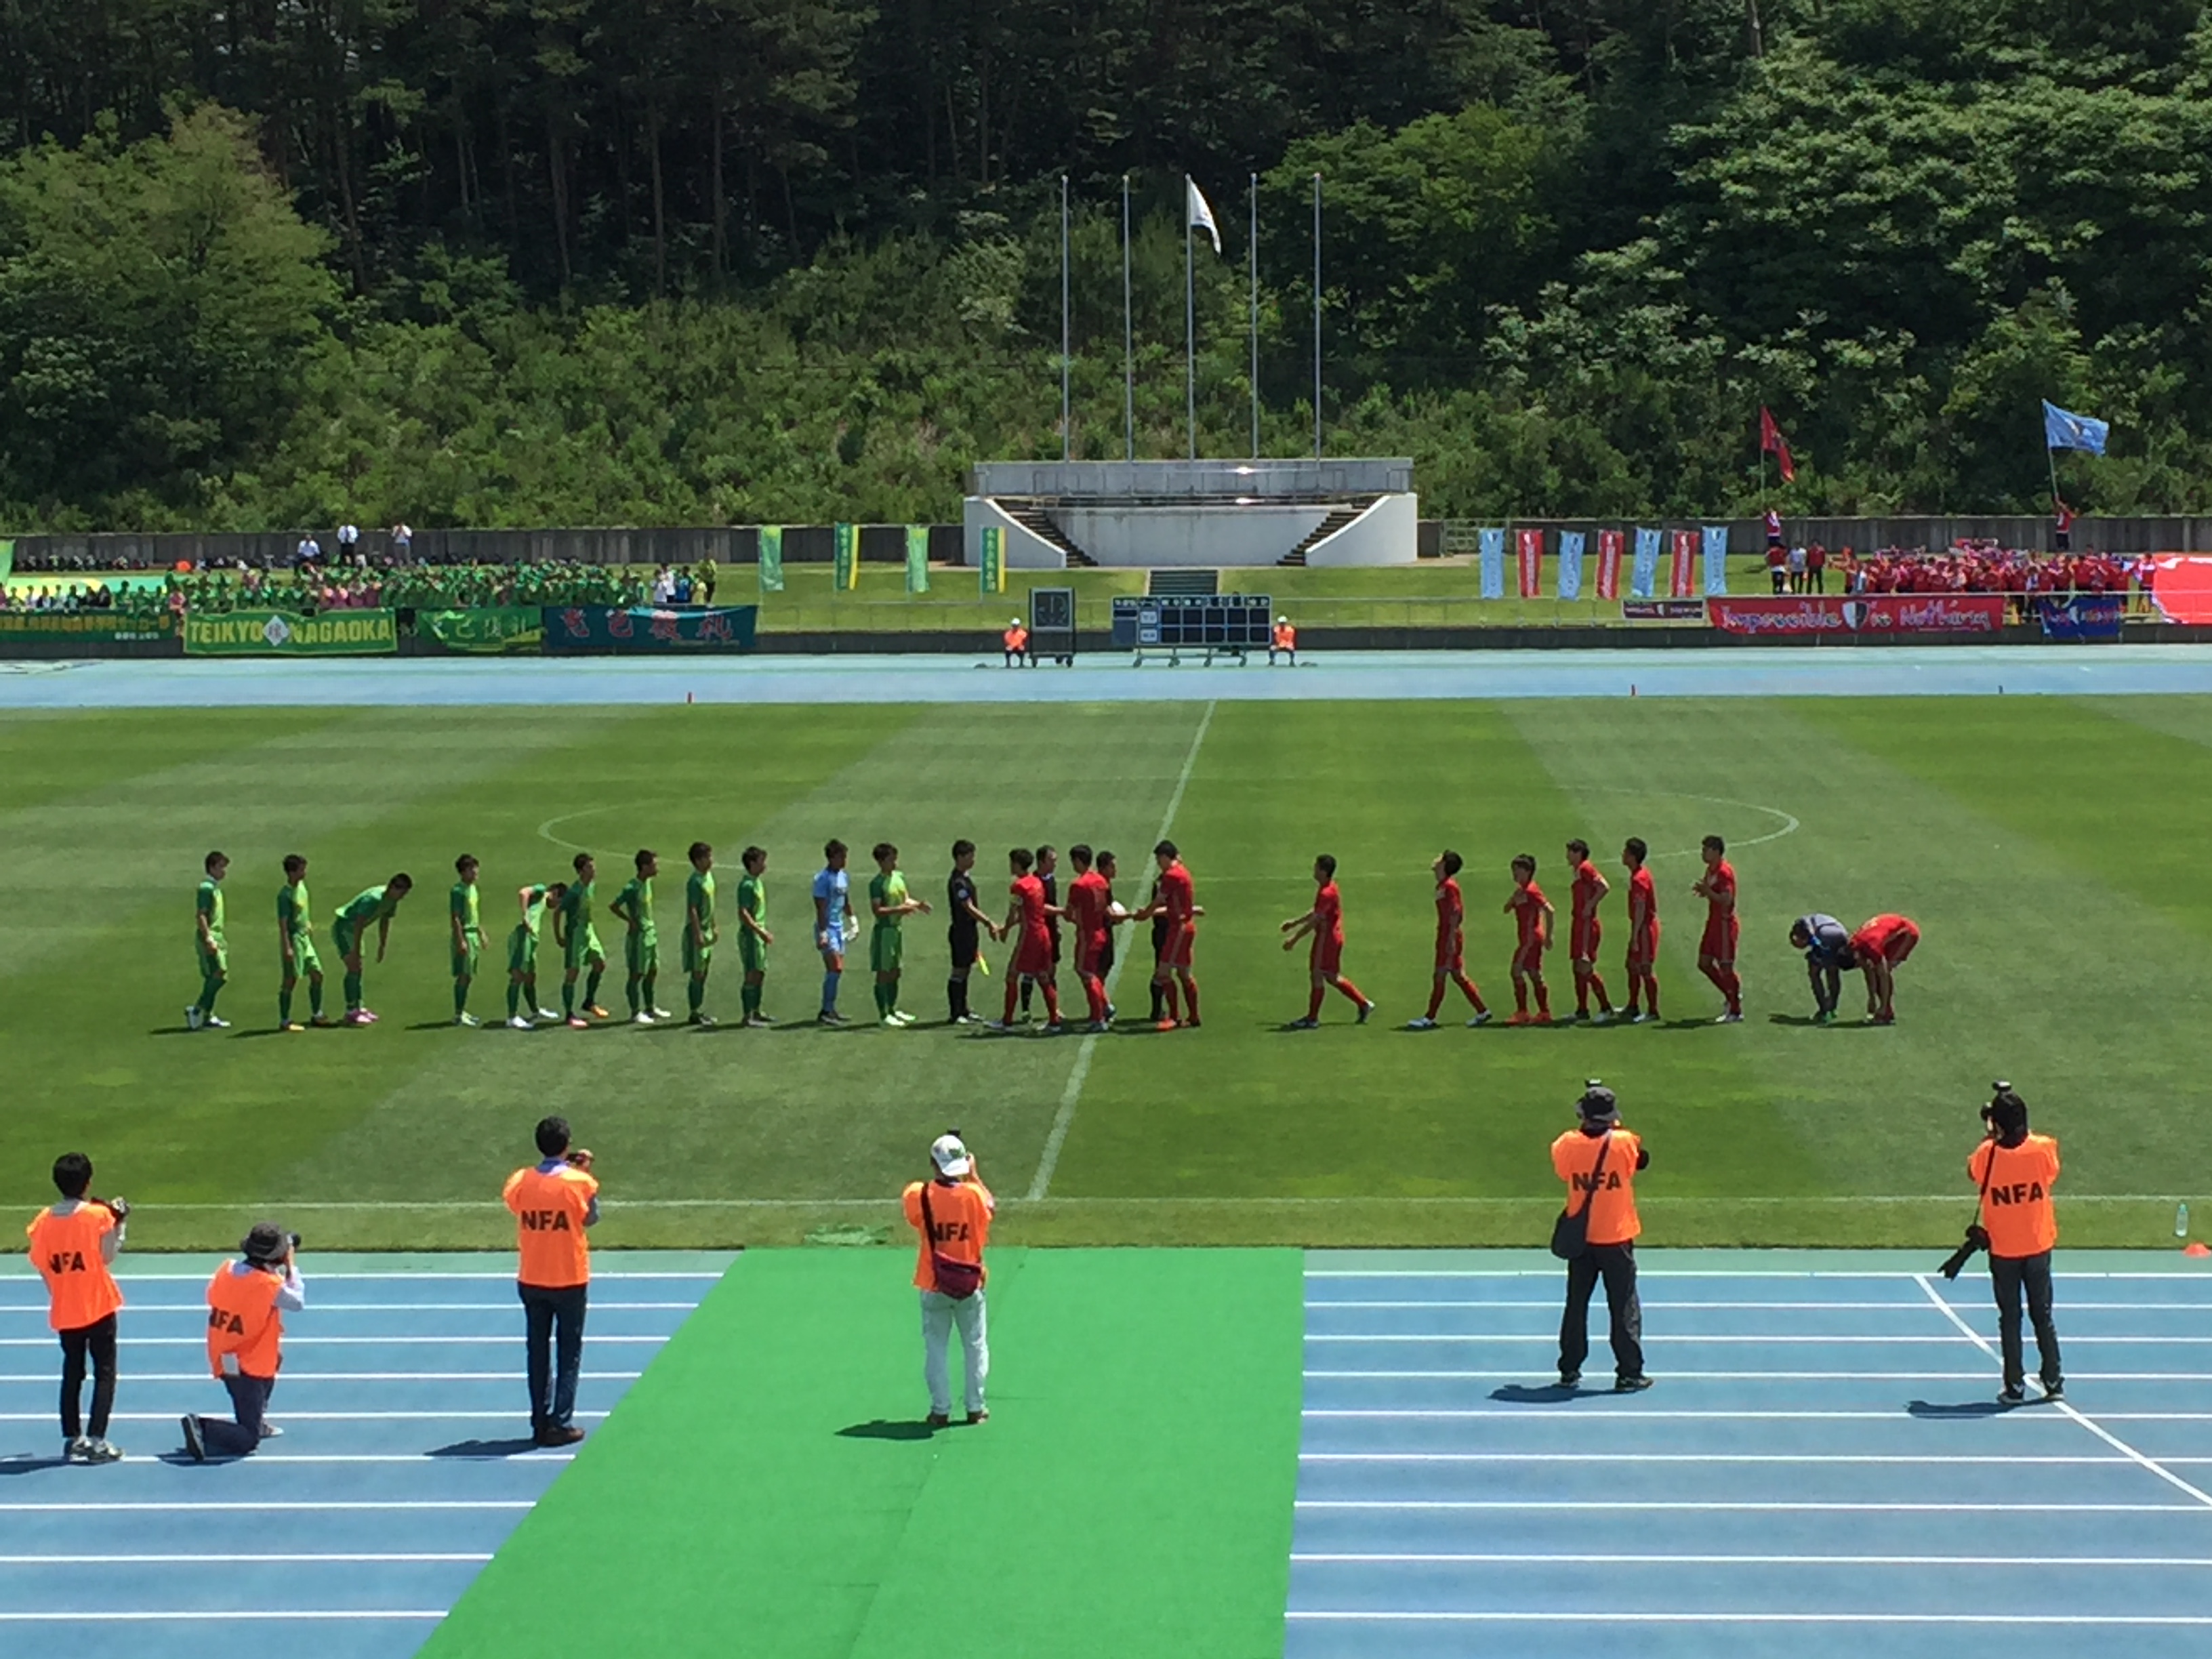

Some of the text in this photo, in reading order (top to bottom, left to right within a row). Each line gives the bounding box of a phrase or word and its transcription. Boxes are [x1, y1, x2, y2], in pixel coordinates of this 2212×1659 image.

[190, 621, 264, 642] TEIKYO
[287, 619, 392, 642] NAGAOKA
[1571, 1170, 1622, 1191] NFA
[1990, 1181, 2043, 1206] NFA
[521, 1209, 569, 1231] NFA
